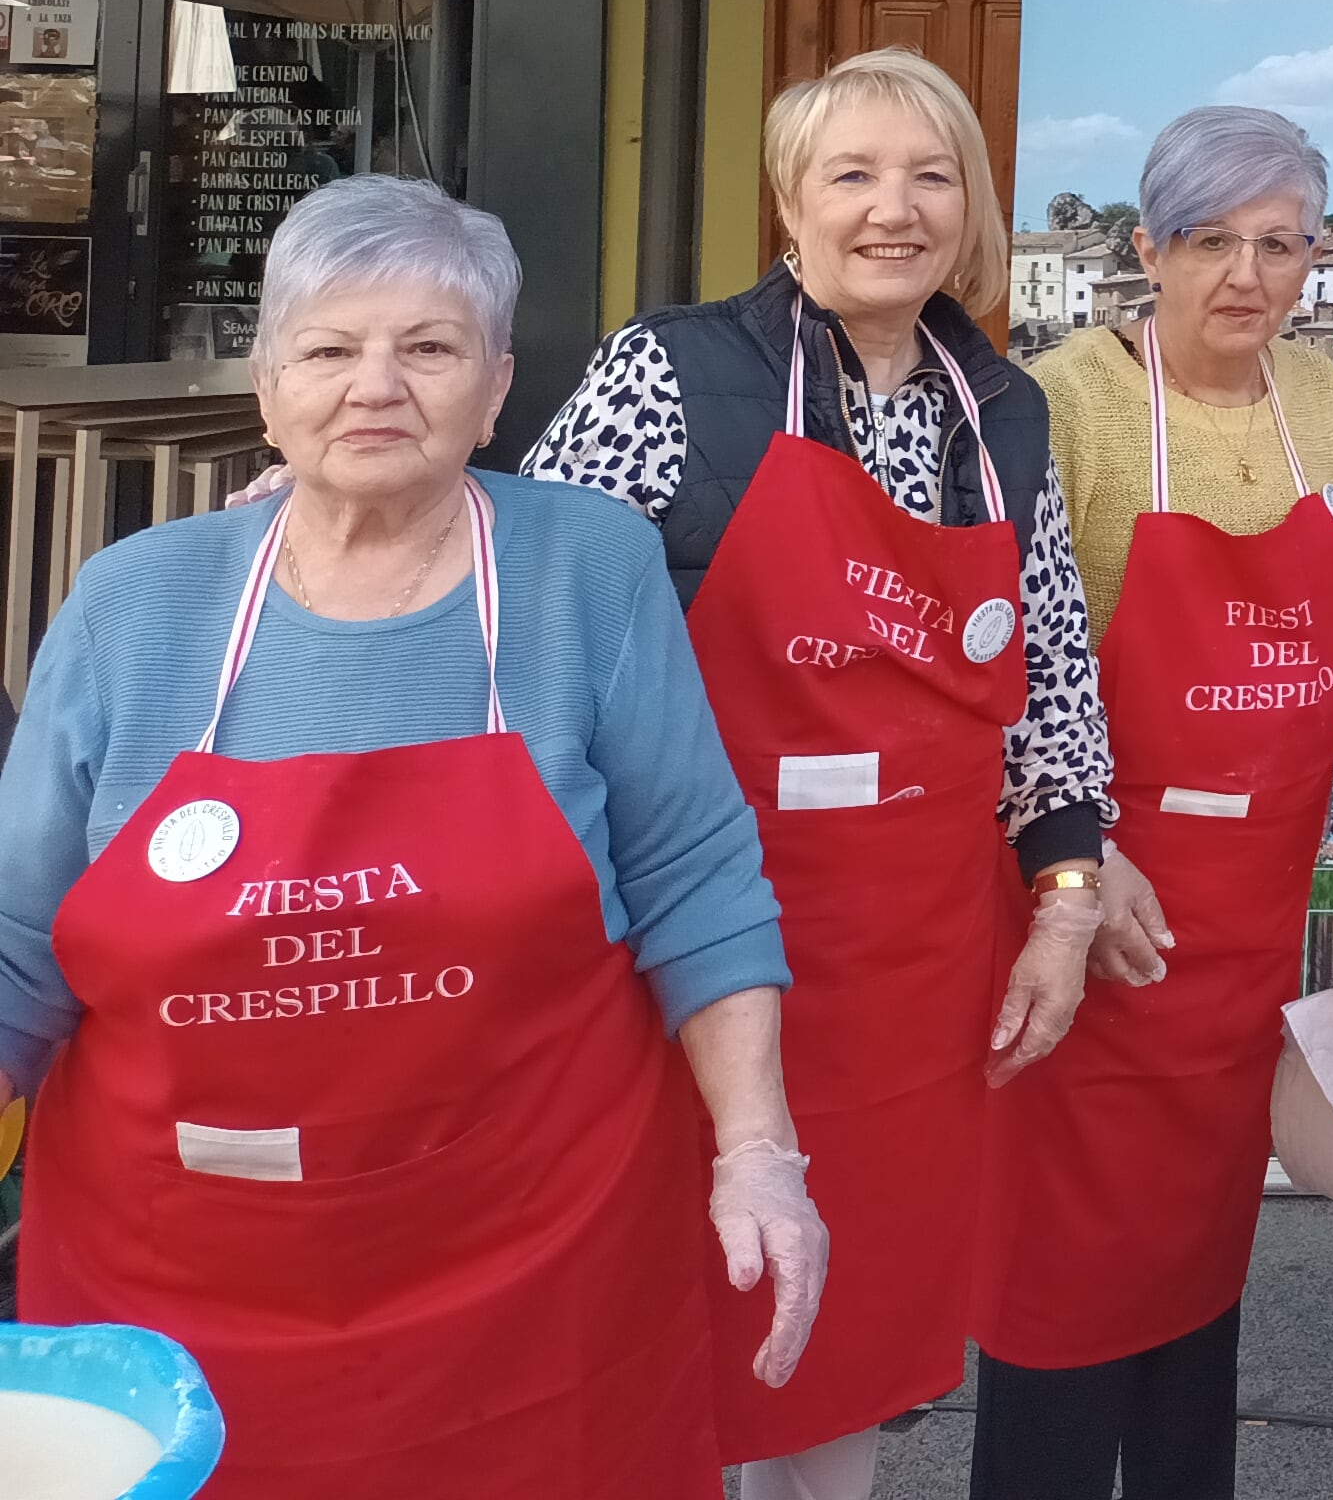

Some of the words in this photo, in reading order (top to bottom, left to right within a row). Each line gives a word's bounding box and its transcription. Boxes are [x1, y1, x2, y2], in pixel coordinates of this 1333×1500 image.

[252, 22, 260, 39] Y
[265, 22, 282, 39] 24
[286, 22, 327, 40] HORAS
[331, 23, 346, 40] DE
[252, 65, 308, 82] CENTENO
[233, 86, 293, 104] INTEGRAL
[204, 108, 228, 124] PAN
[251, 108, 312, 125] SEMILLAS
[316, 109, 331, 126] DE
[250, 130, 305, 147] ESPELTA
[202, 151, 226, 168] PAN
[229, 151, 288, 169] GALLEGO
[201, 173, 250, 190] BARRAS
[253, 173, 320, 191] GALLEGAS
[200, 194, 224, 211] PAN
[228, 194, 243, 211] DE
[198, 215, 264, 233] CHAPATAS
[198, 237, 222, 254] PAN
[226, 238, 242, 254] DE
[196, 280, 221, 298] PAN
[223, 281, 245, 298] SIN
[865, 610, 935, 663] DEL
[1249, 641, 1320, 668] DEL
[225, 862, 422, 917] FIESTA
[262, 926, 382, 967] DEL
[159, 965, 475, 1027] CRESPILLO
